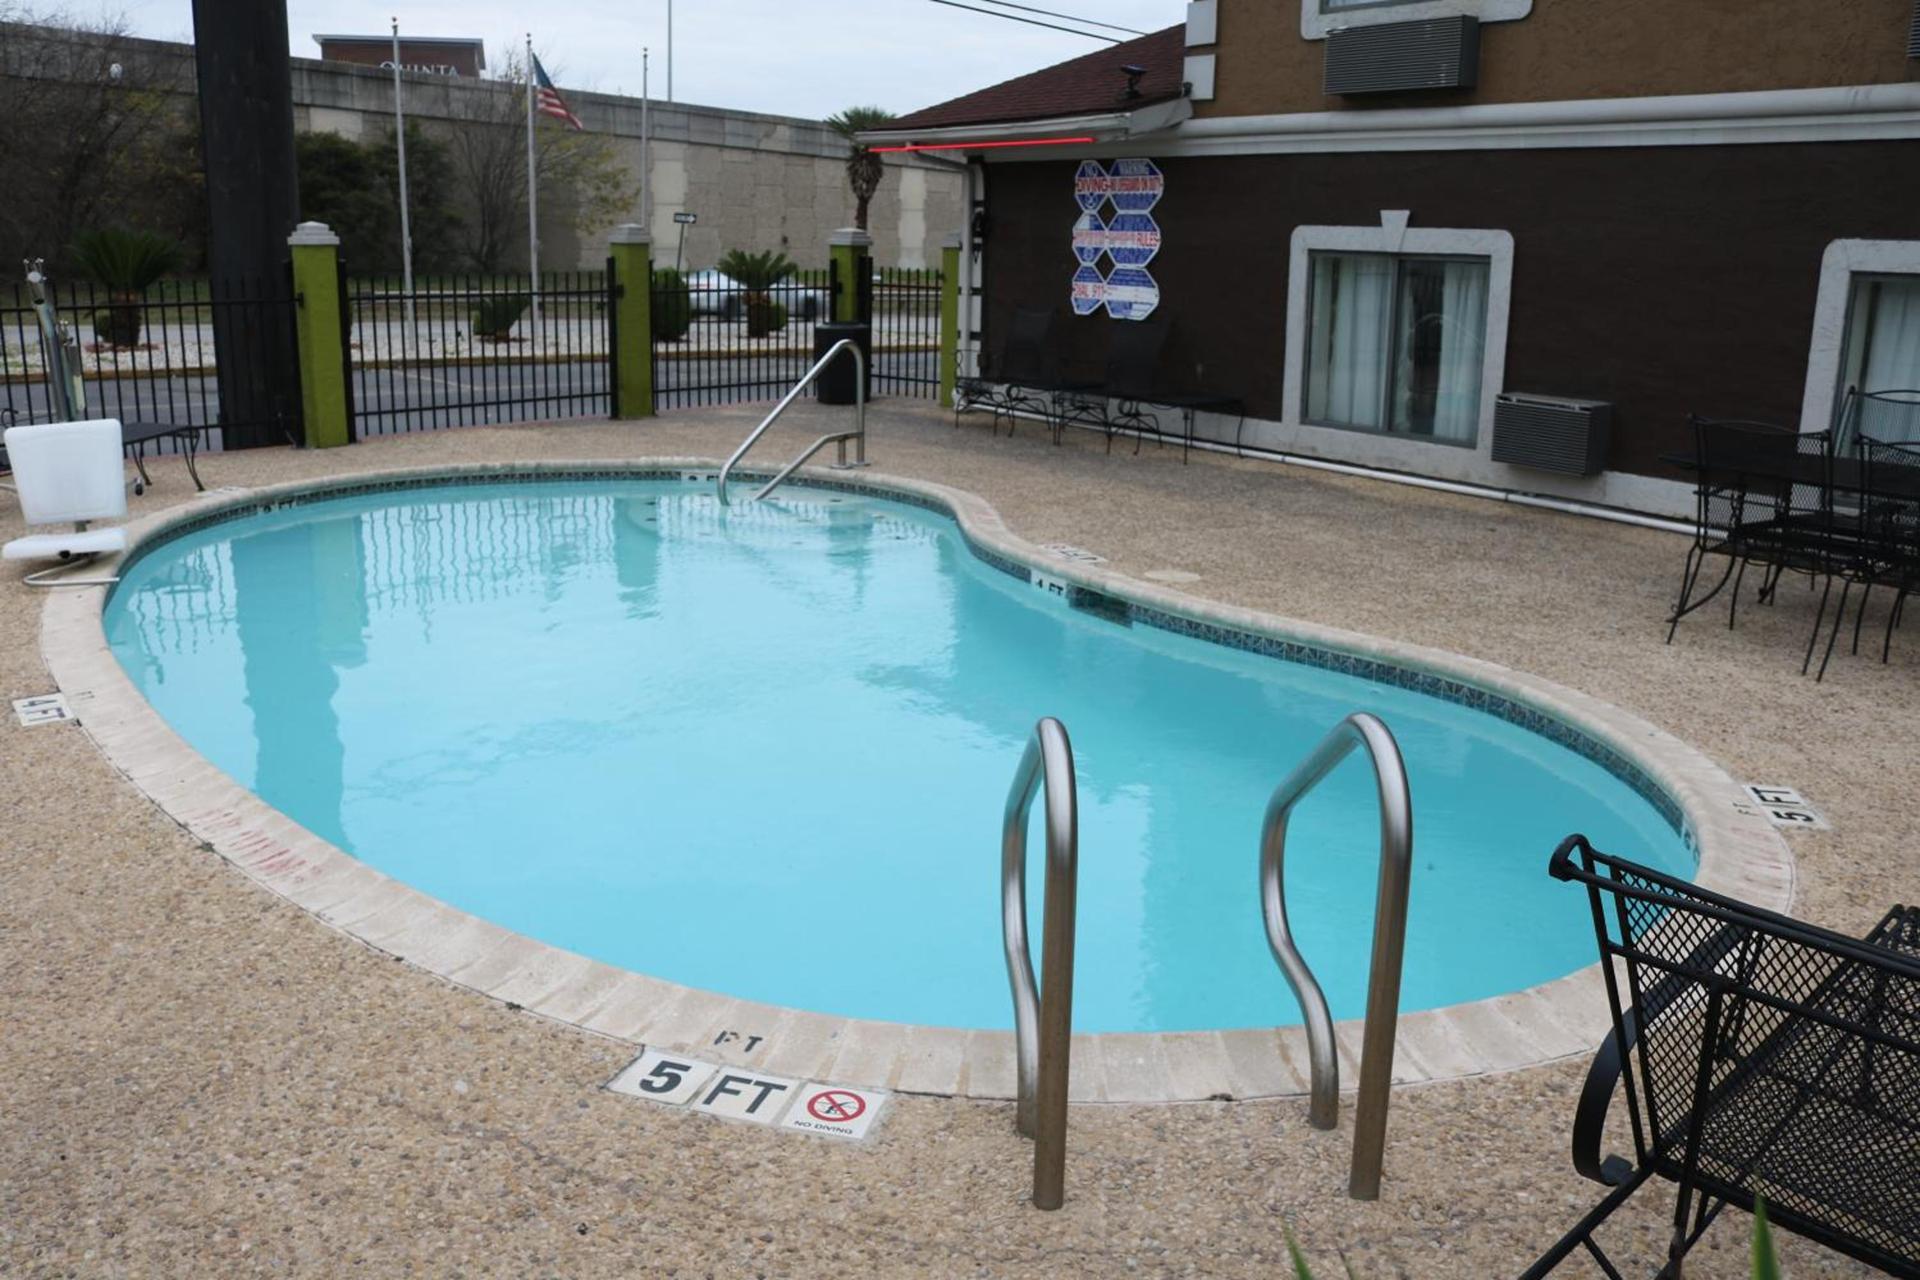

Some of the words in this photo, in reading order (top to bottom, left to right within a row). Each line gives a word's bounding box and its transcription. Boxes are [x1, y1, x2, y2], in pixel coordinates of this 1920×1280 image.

[1078, 177, 1107, 192] DIVING
[1137, 231, 1158, 247] RULES
[1750, 787, 1801, 804] FT
[1772, 810, 1814, 822] 5
[640, 1060, 693, 1094] 5
[702, 1073, 788, 1114] FT
[793, 1120, 812, 1129] NO
[814, 1122, 853, 1135] DIVING
